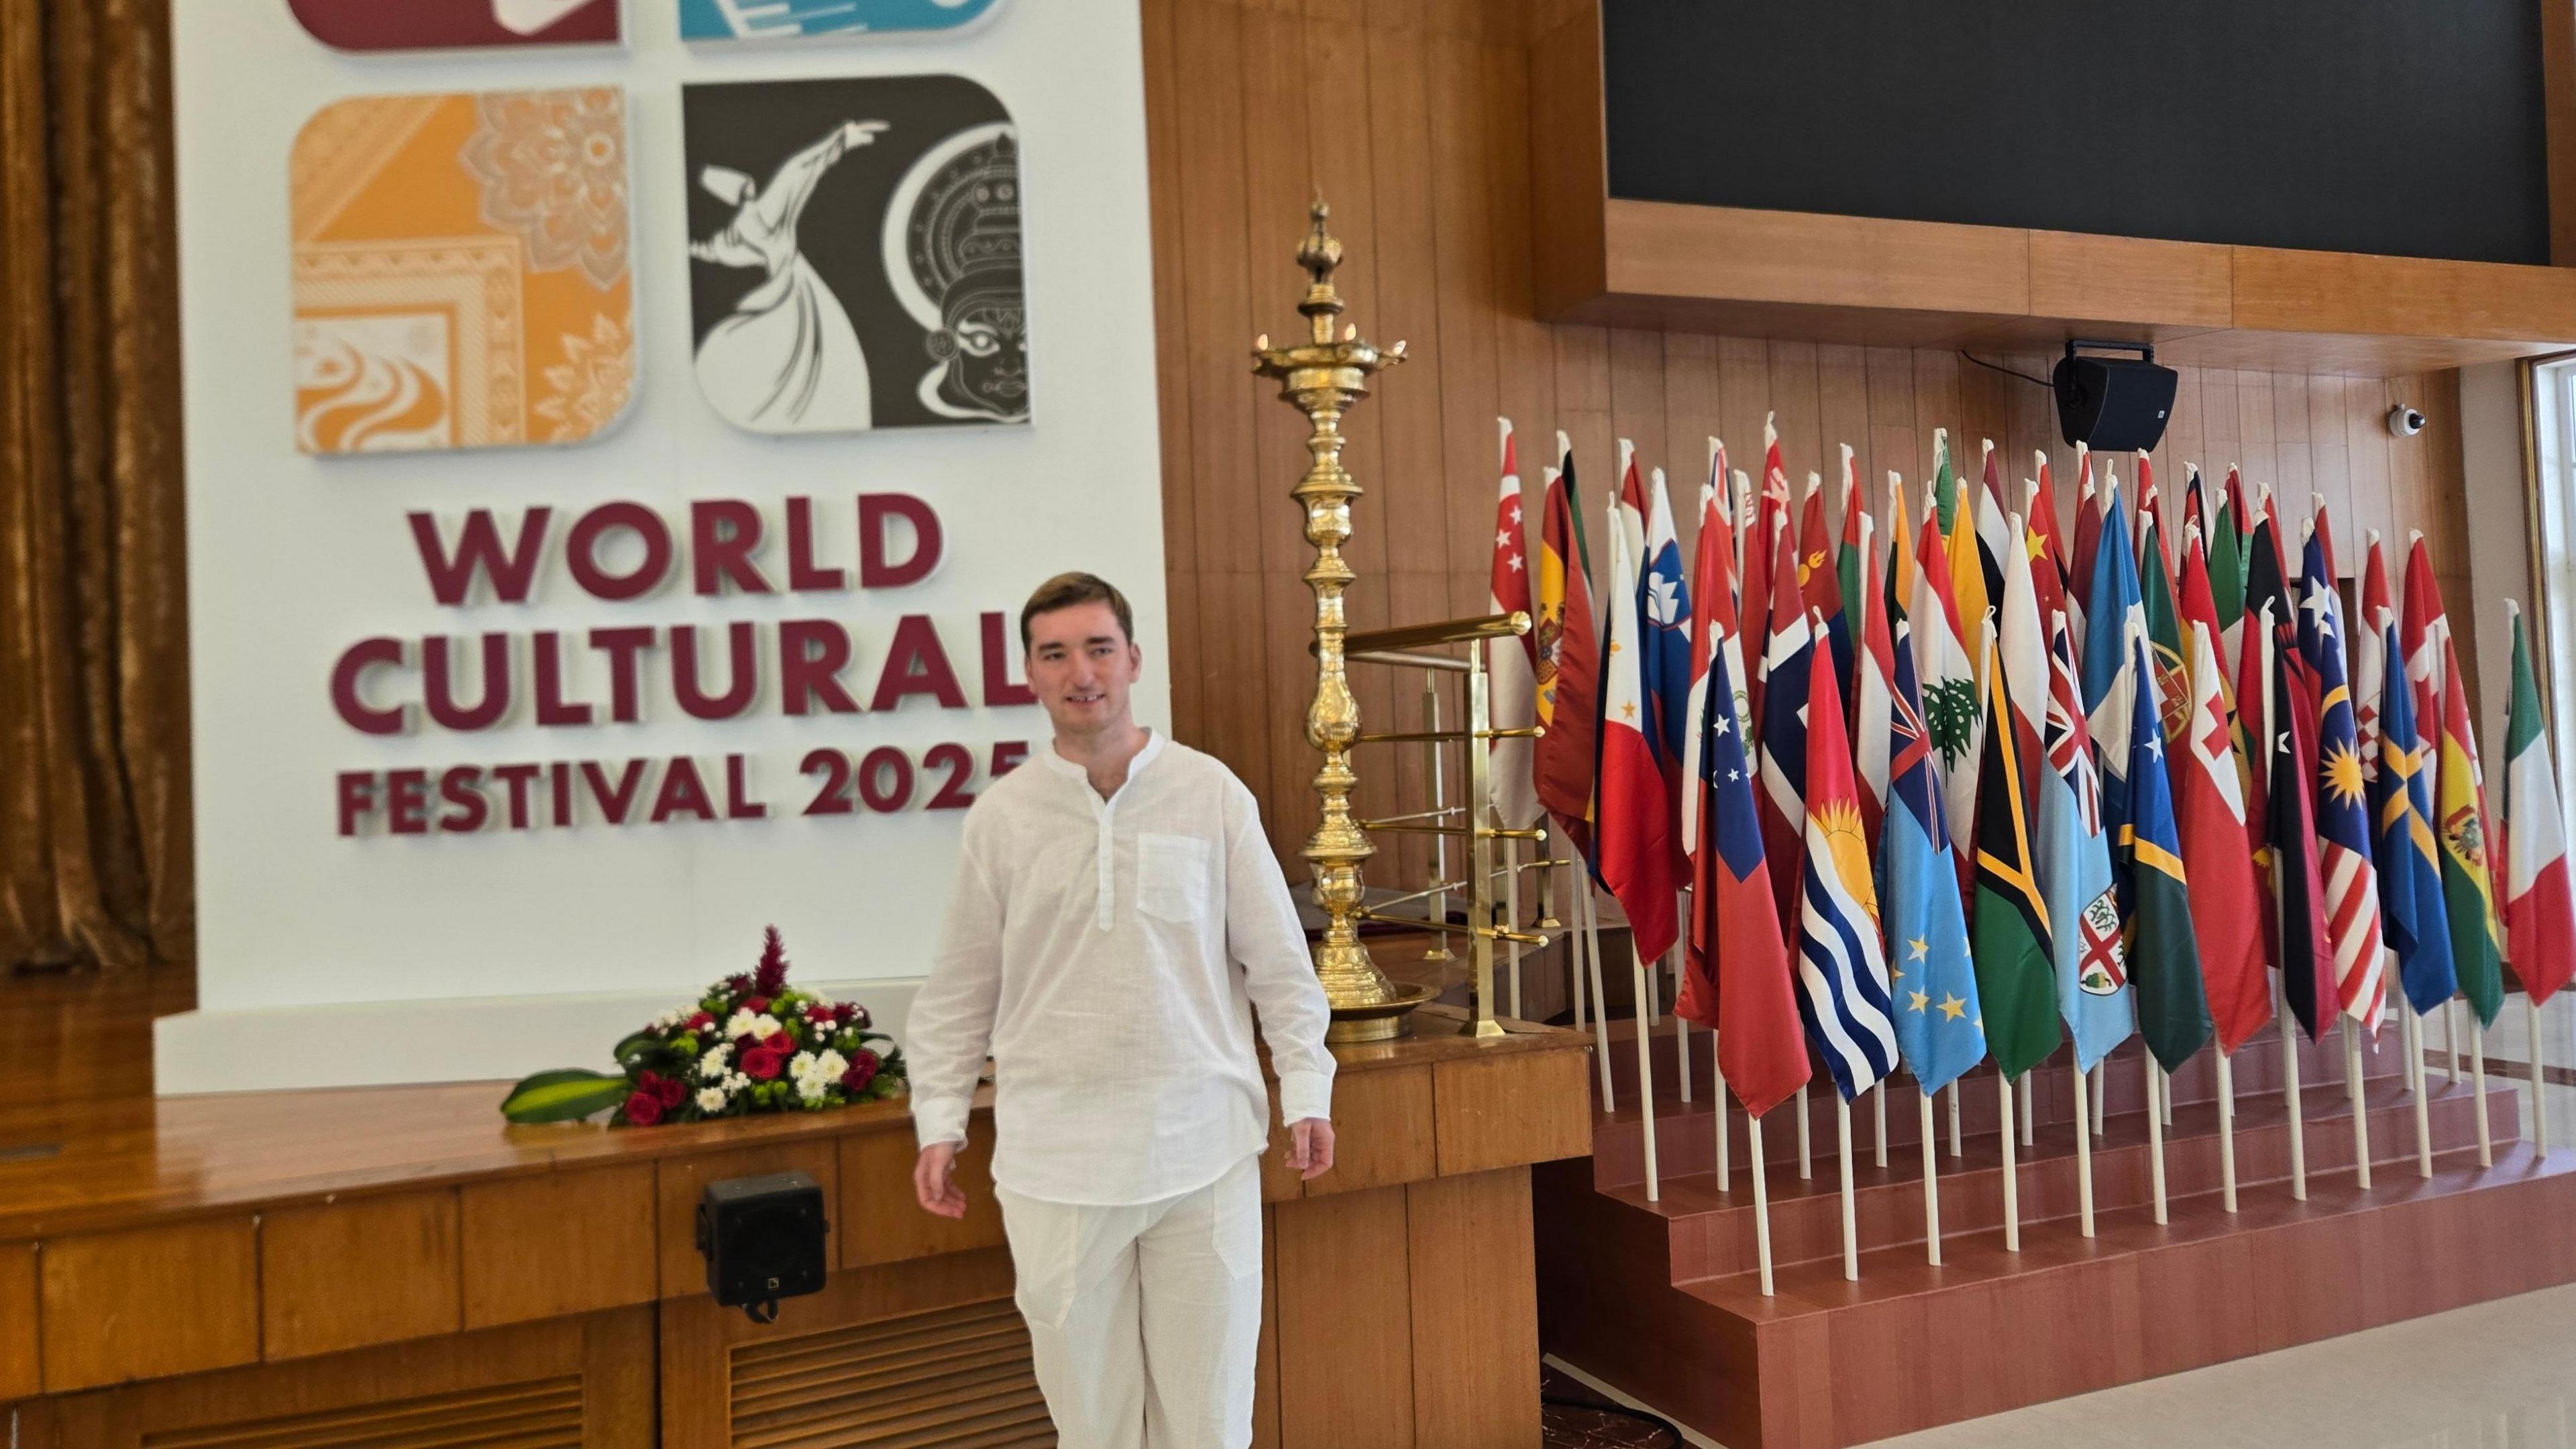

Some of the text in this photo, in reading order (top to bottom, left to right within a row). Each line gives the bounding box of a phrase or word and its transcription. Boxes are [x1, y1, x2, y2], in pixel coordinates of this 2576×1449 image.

[408, 492, 941, 605] WORLD
[331, 611, 1040, 735] CULTURAL
[337, 754, 765, 836] FESTIVAL
